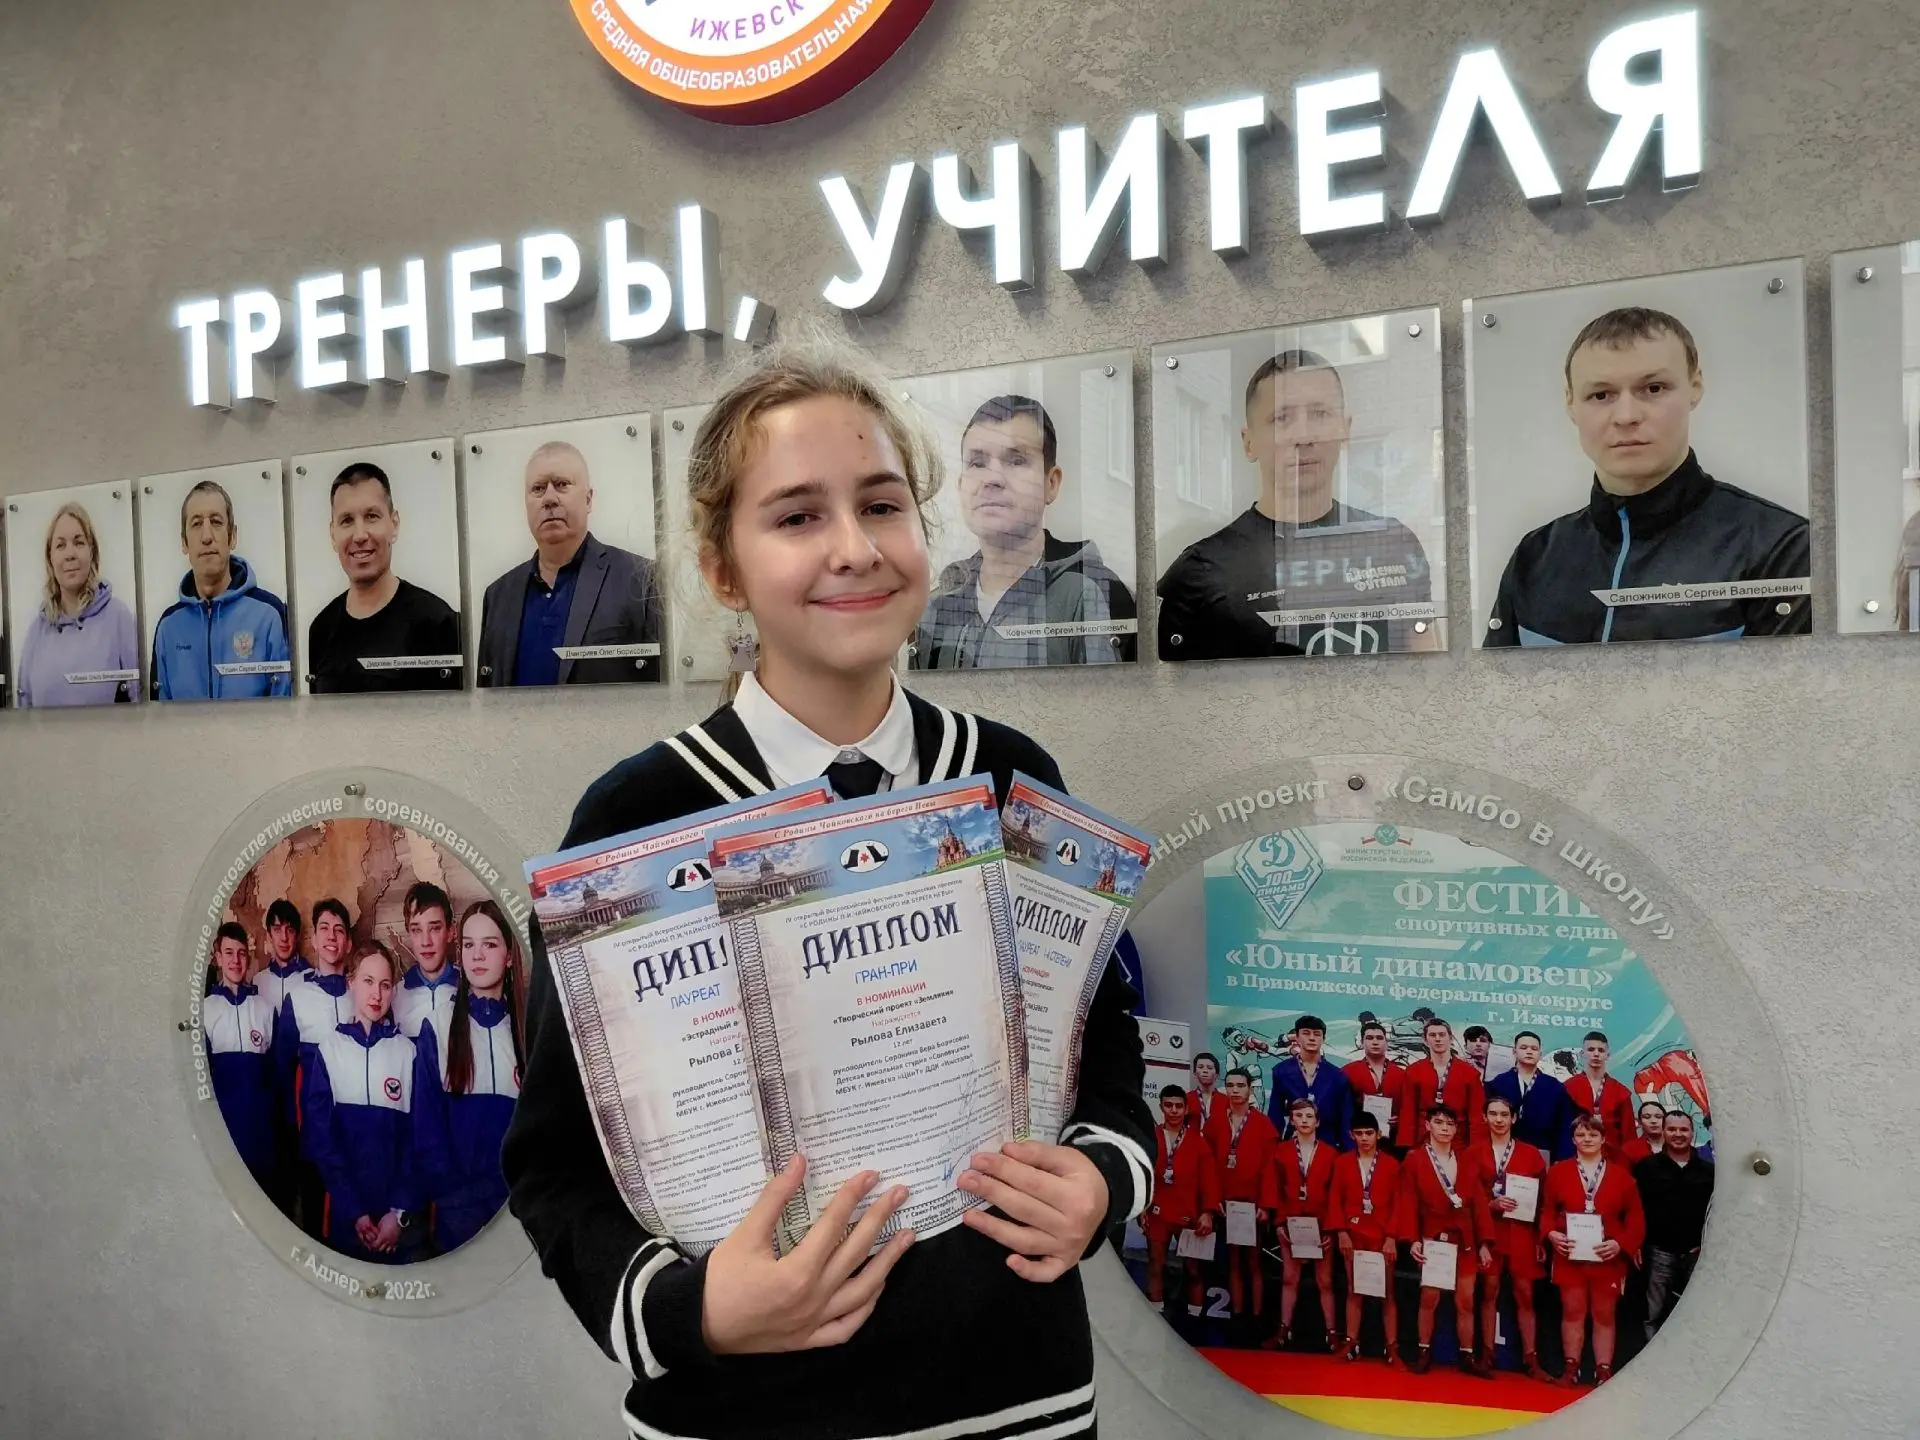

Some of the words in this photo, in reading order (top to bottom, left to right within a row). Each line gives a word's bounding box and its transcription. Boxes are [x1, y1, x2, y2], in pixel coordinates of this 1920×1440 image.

[591, 0, 650, 69] СРЕДНЯЯ
[178, 204, 757, 407] ТРЕНЕРЫ,
[818, 8, 1702, 312] УЧИТЕЛЯ
[1609, 589, 1681, 604] Сапожников
[1684, 586, 1727, 599] Сергей
[1730, 583, 1804, 597] Валерьевич
[1043, 626, 1075, 636] Сергей
[1273, 613, 1327, 624] Прокопьев
[1329, 610, 1385, 621] Александр
[1387, 606, 1437, 618] Юрьевич
[783, 823, 818, 839] Родины
[819, 811, 874, 832] Чайковского
[915, 799, 937, 812] Невы
[641, 831, 699, 852] Чайковского
[1216, 777, 1329, 827] проект
[1384, 777, 1522, 830] «Самбо
[1529, 822, 1554, 847] в
[1560, 838, 1677, 942] школу»
[1257, 881, 1307, 898] ДИНАМО
[1014, 896, 1088, 947] ДИПЛОМ
[1394, 917, 1550, 940] спортивных
[187, 924, 212, 1101] Всероссийские
[206, 796, 344, 921] легкоатлетические
[363, 795, 500, 886] соревнования
[801, 900, 963, 980] ДИПЛОМ
[854, 958, 919, 985] ГРАН-ПРИ
[1225, 942, 1362, 976] «Юный
[1372, 955, 1613, 990] динамовец»
[670, 982, 722, 1010] ЛАУРЕАТ
[833, 1004, 885, 1026] «Творческий
[885, 998, 913, 1015] проект
[913, 989, 955, 1007] «Земляки»
[856, 996, 865, 1006] В
[865, 980, 928, 1005] НОМИНАЦИИ
[1226, 975, 1238, 988] в
[1241, 972, 1384, 997] Приволжском
[1388, 983, 1534, 1007] федеральном
[1536, 993, 1614, 1011] округе
[850, 1030, 895, 1048] Рылова
[895, 1015, 948, 1037] Елизавета
[1487, 1012, 1505, 1025] г.
[1511, 1008, 1604, 1030] Ижевск
[689, 1048, 733, 1068] Рылова
[290, 1246, 301, 1262] г.
[304, 1253, 364, 1297] Адлер,
[384, 1280, 436, 1301] 2022г.
[1206, 1286, 1232, 1319] 2
